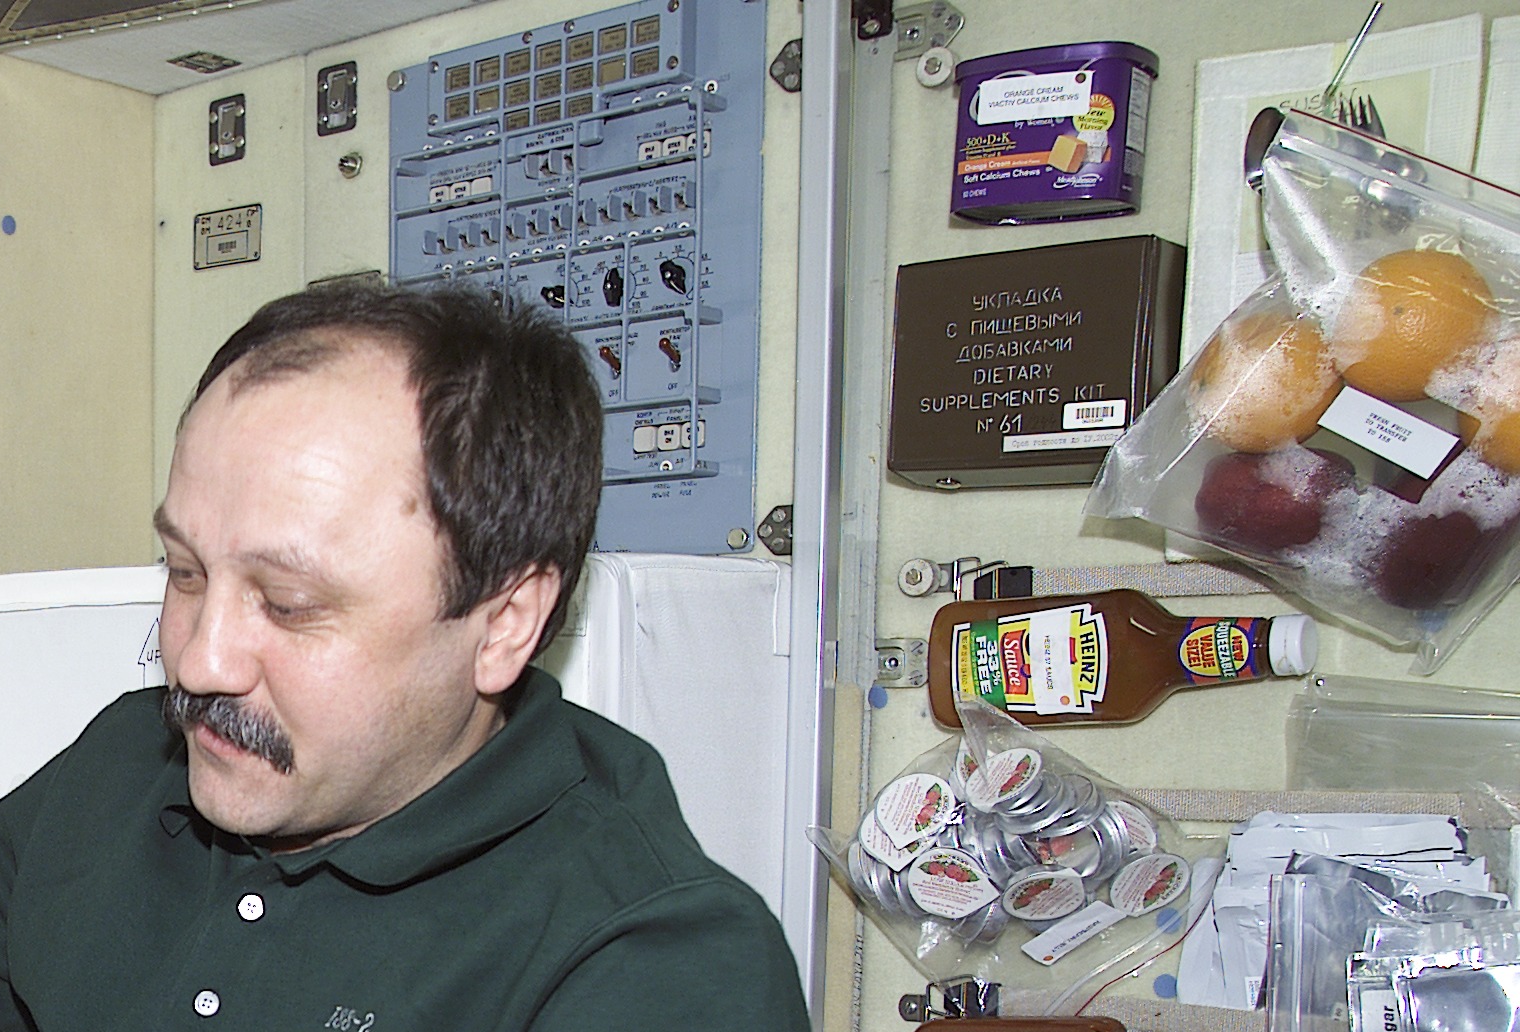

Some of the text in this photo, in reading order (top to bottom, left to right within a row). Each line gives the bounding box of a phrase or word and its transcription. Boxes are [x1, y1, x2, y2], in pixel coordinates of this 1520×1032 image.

[963, 169, 1041, 184] Soft Calcium Chews
[972, 286, 1063, 311] УКЛАДКА
[946, 311, 1083, 338] С ПИЩЕВЫМИ
[955, 337, 1073, 363] ДОБАВКАМИ
[973, 363, 1054, 385] DIETARY
[920, 383, 1107, 413] SUPPLEMENTS KIT
[999, 414, 1023, 434] 61
[1003, 638, 1022, 687] Sauce
[1079, 631, 1096, 684] HEINZ
[1200, 634, 1216, 668] VALUE
[1215, 621, 1237, 678] SQUEEZABLE
[1232, 635, 1244, 662] NEW
[975, 635, 993, 695] FREE
[987, 640, 1002, 686] 33%
